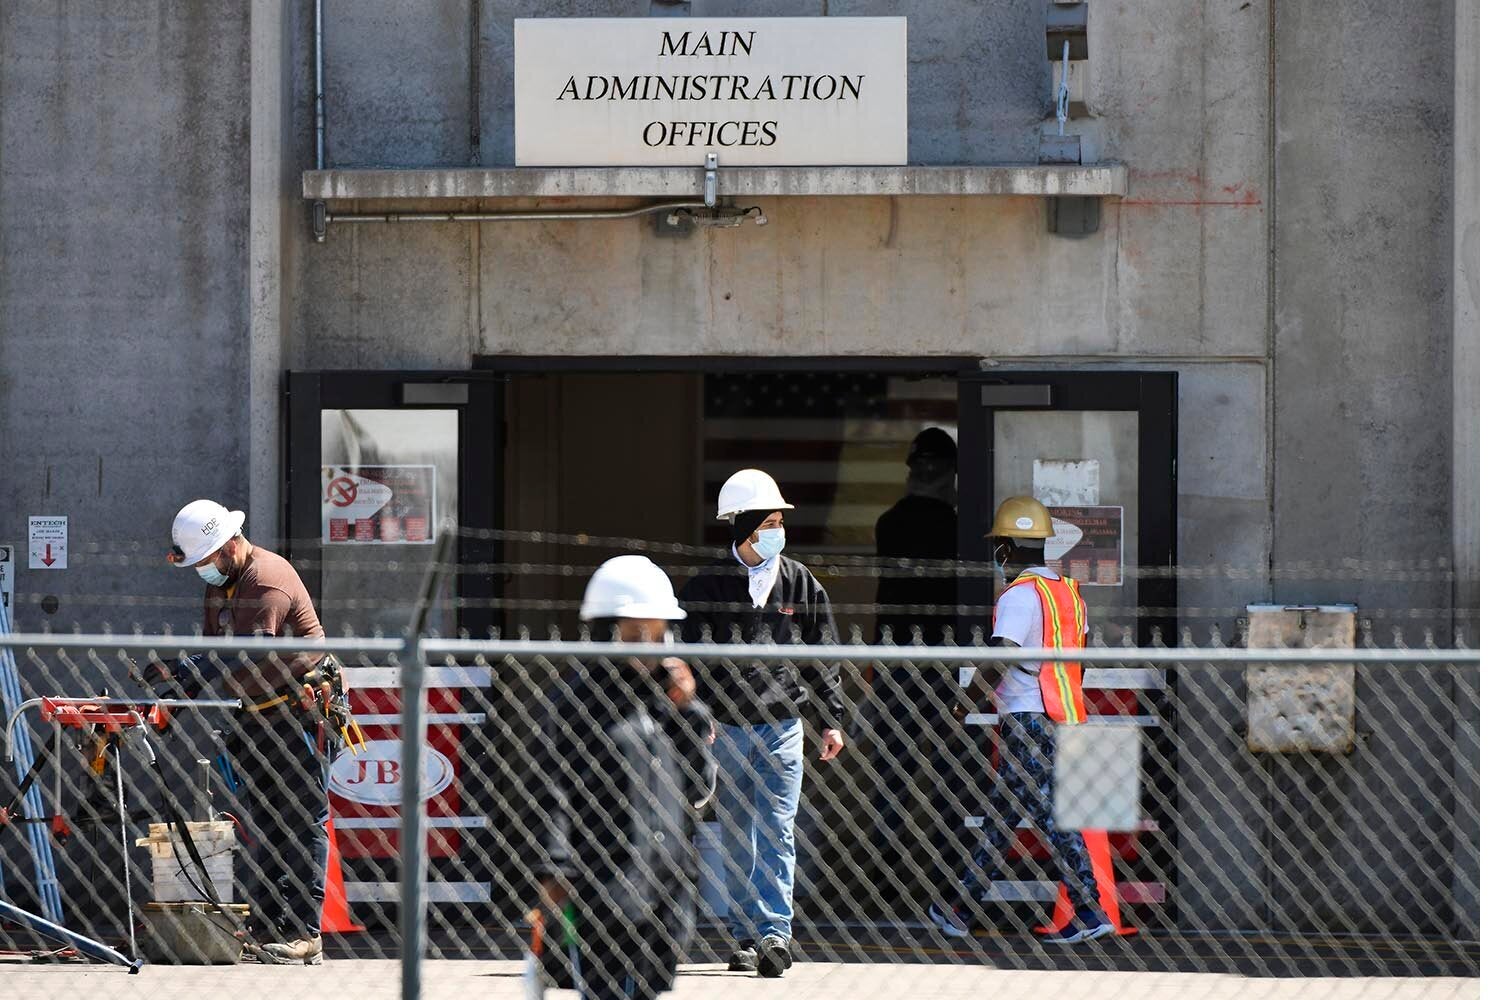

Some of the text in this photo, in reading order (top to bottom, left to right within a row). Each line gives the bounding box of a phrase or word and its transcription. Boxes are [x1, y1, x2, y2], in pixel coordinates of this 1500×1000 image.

[658, 31, 757, 57] MAIN
[556, 75, 866, 101] ADMINISTRATION
[642, 120, 779, 147] OFFICES
[346, 760, 402, 784] JB
